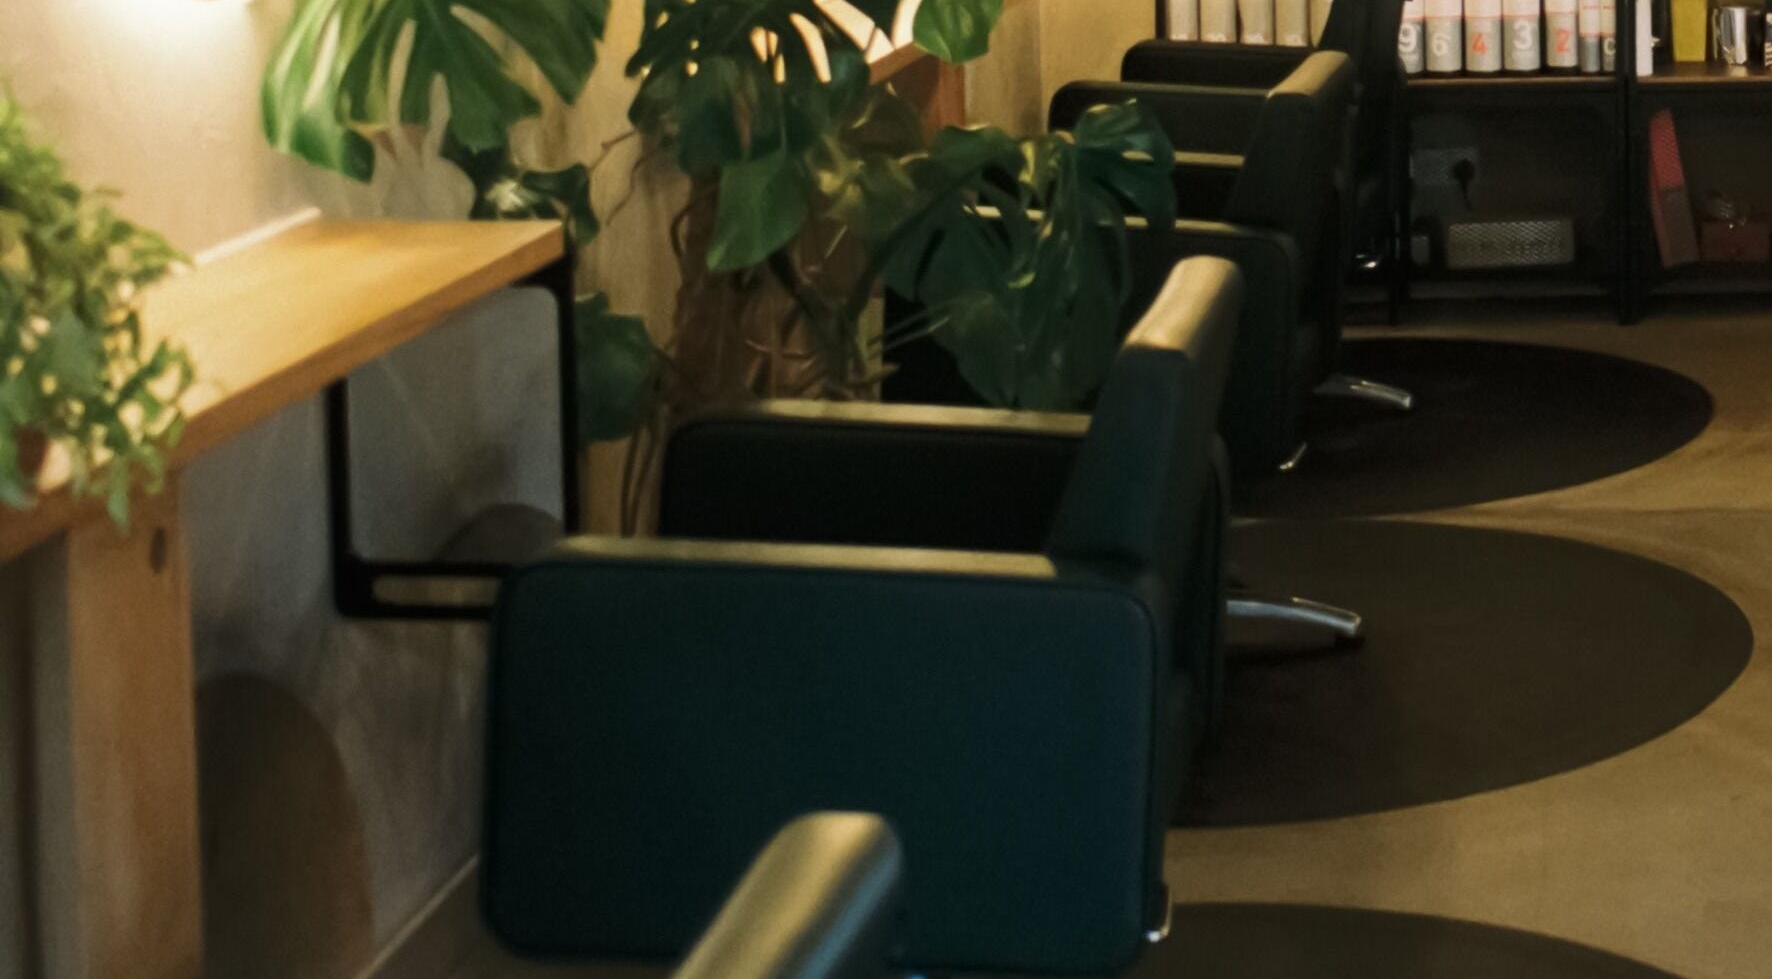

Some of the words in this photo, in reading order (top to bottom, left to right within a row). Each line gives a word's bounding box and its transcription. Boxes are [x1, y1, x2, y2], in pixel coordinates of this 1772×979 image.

[1399, 24, 1417, 53] 9
[1433, 33, 1450, 56] 6
[1472, 32, 1487, 55] 4
[1514, 20, 1532, 50] 3
[1556, 30, 1571, 52] 2
